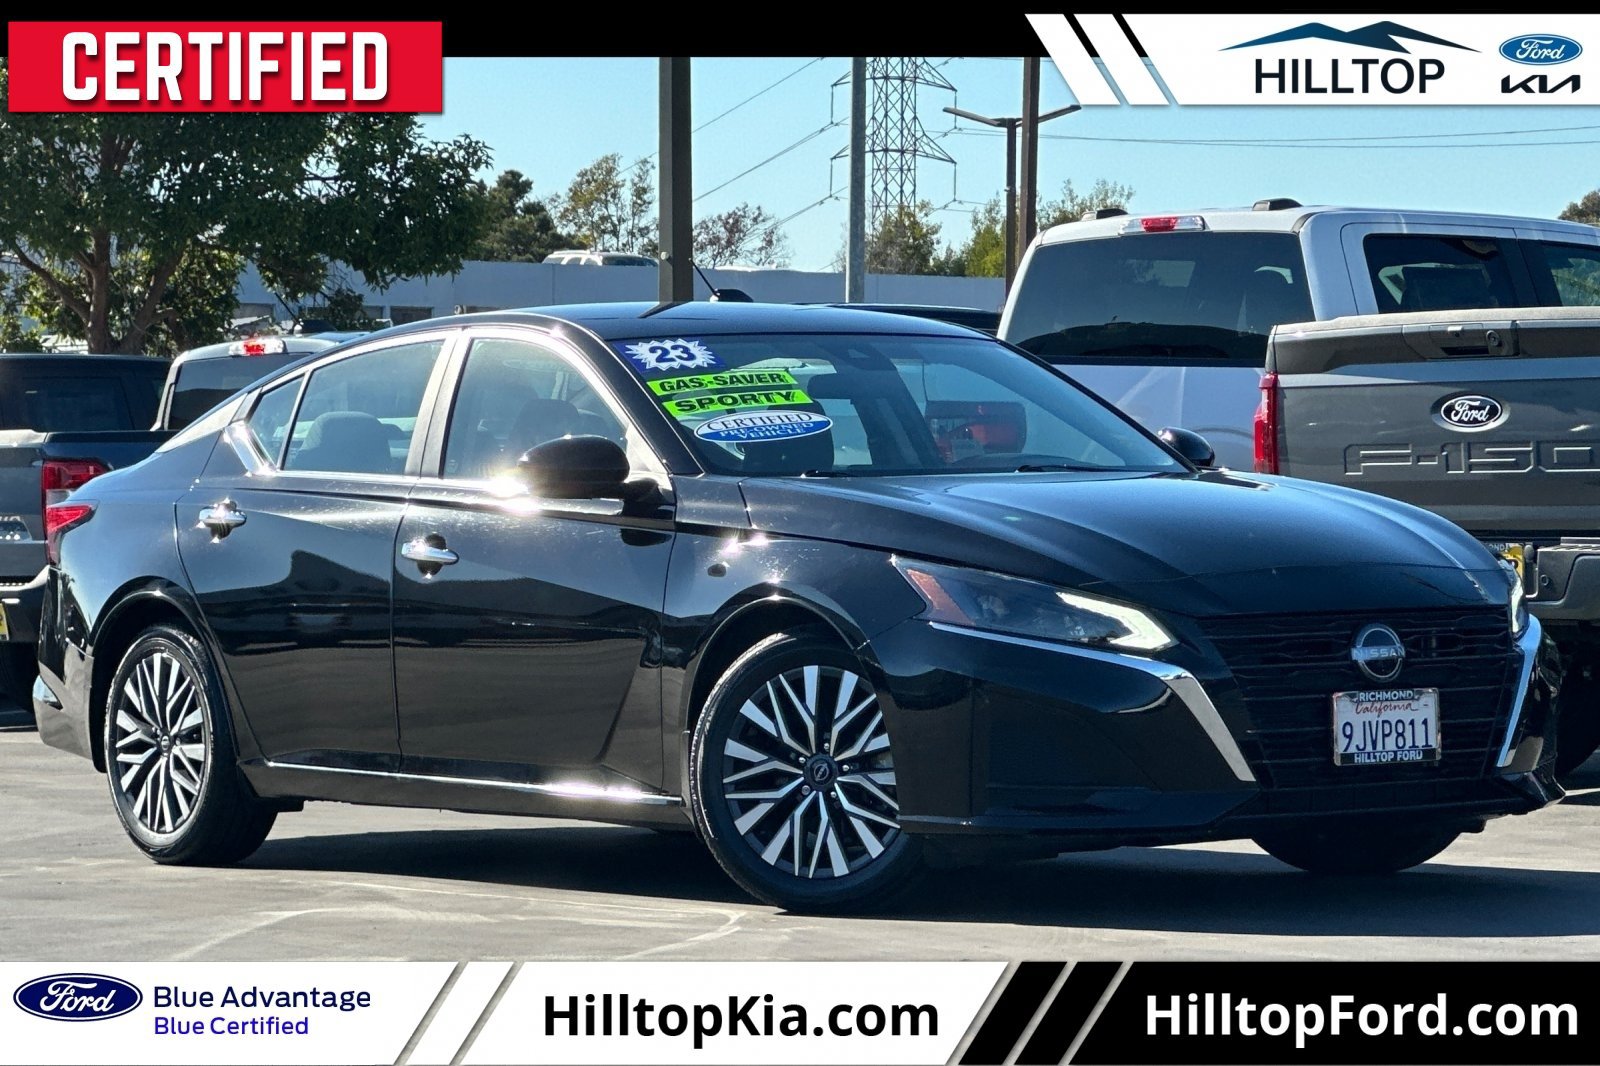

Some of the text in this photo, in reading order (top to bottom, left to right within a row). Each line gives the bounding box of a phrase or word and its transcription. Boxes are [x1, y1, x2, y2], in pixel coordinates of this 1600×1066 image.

[648, 345, 697, 362] 23
[659, 372, 786, 392] GAS-SAVER
[675, 391, 793, 412] SPORTY
[1451, 400, 1489, 421] Ford
[706, 412, 813, 432] CERTIFIED
[719, 422, 814, 437] PRE-OWNED
[737, 427, 806, 439] VEHICLE
[1344, 441, 1600, 476] F-150
[1352, 647, 1405, 659] NISSAN
[1359, 691, 1413, 701] RICHMOND
[1355, 700, 1419, 717] California
[1342, 718, 1433, 752] 9JVP811
[1354, 751, 1423, 763] HILLTOP FORD
